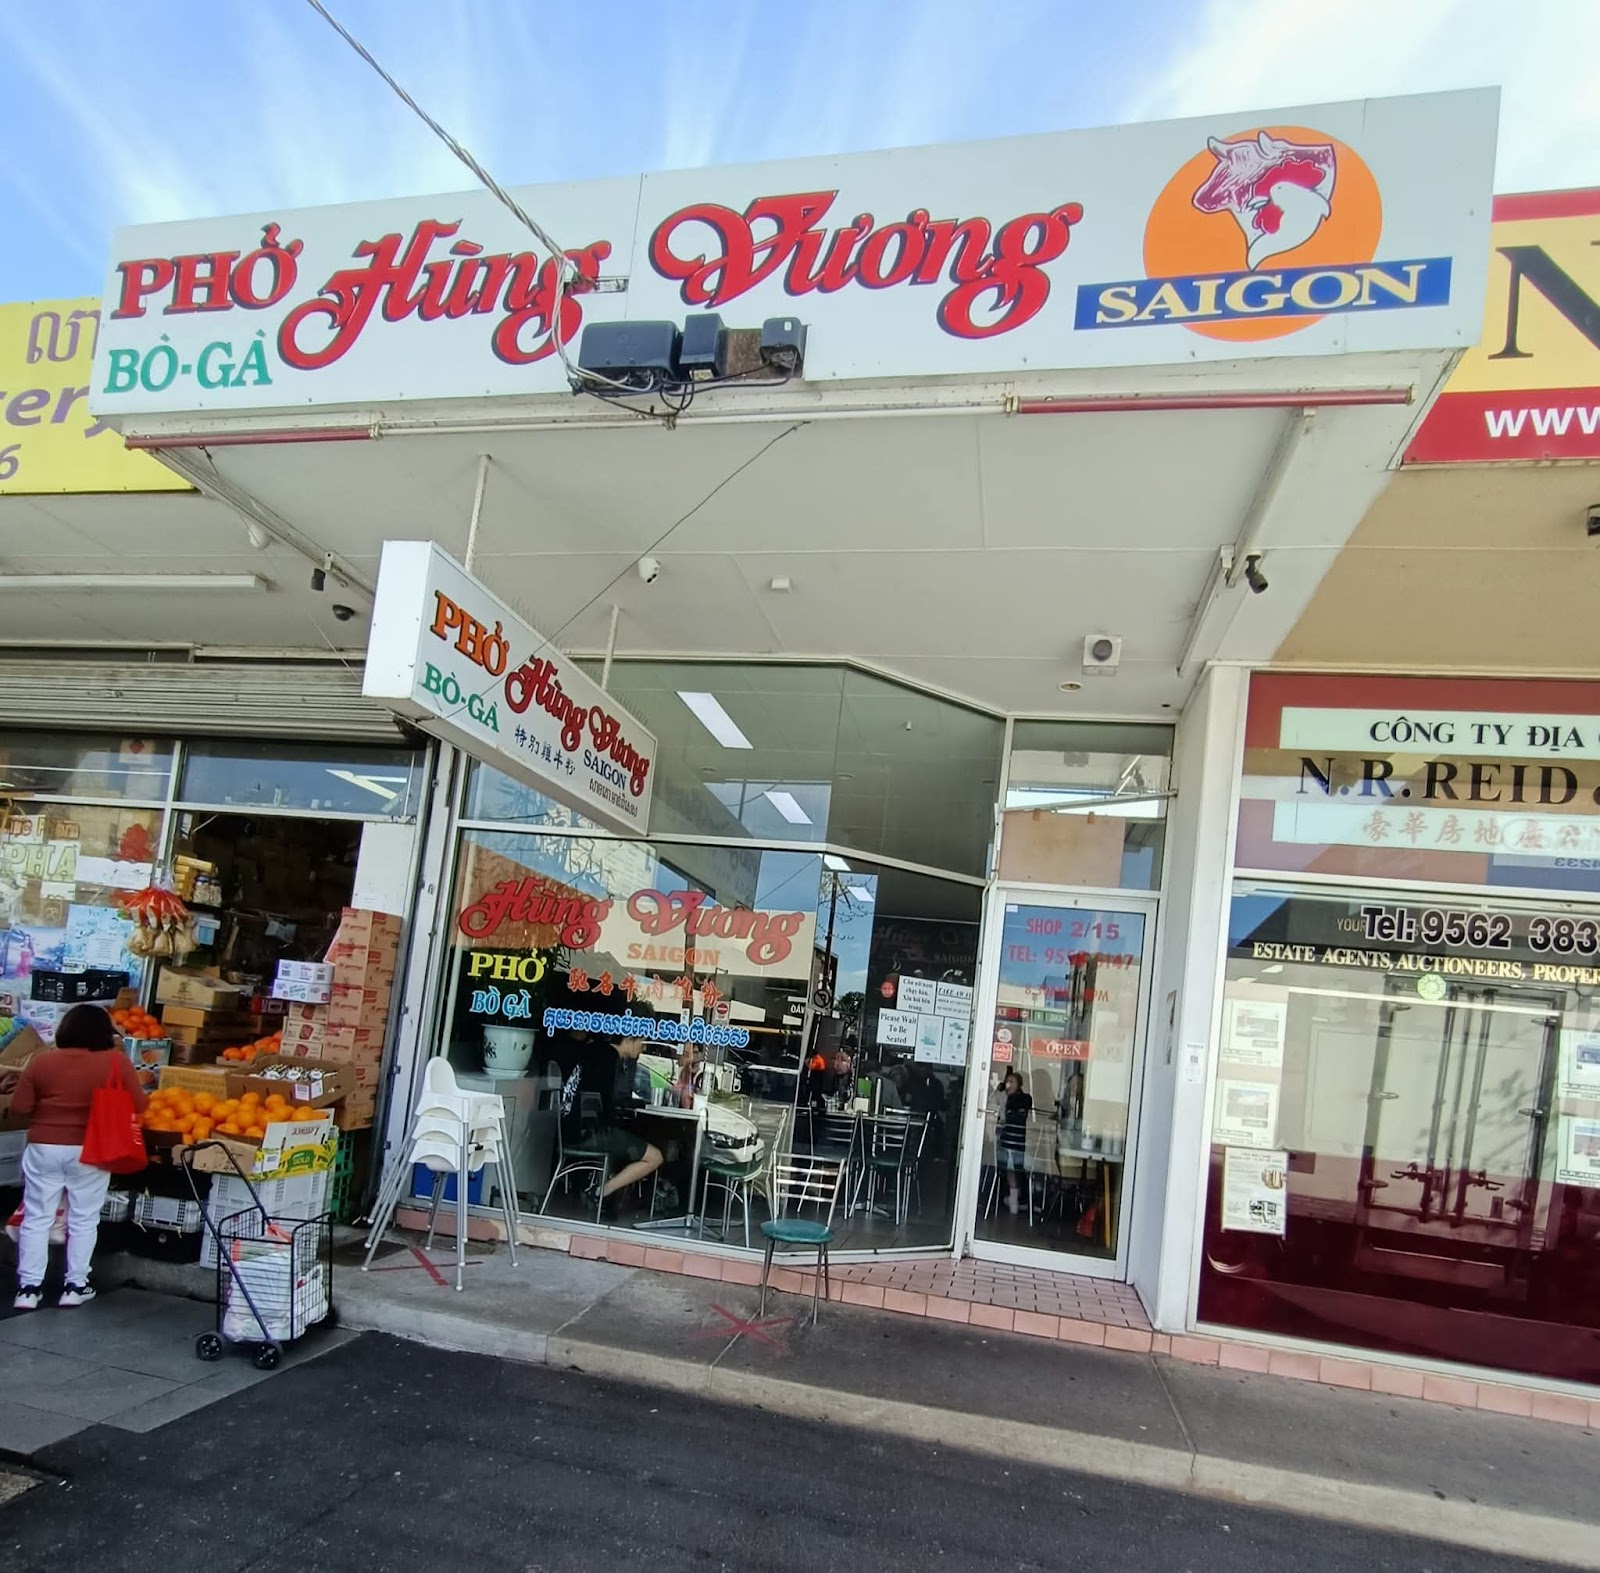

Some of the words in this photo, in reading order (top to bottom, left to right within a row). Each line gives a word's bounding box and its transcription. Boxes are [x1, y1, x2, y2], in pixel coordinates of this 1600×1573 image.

[111, 222, 304, 320] PHỞ
[277, 219, 611, 370] Hùng
[648, 189, 1084, 339] Vương
[1095, 264, 1427, 324] SAIGON
[430, 590, 510, 676] PHỞ
[505, 654, 588, 752] Hùng
[589, 705, 650, 797] Vương
[1370, 716, 1455, 744] CÔNG
[1471, 723, 1513, 746] TY
[1527, 725, 1585, 751] ĐỊA
[583, 749, 627, 790] SAIGON
[459, 877, 614, 950] Hùng
[626, 888, 805, 965] Vương
[1026, 918, 1063, 935] SHOP
[1070, 921, 1120, 940] 2/15
[1361, 905, 1416, 943] Tel:
[1422, 909, 1512, 950] 9562
[1528, 915, 1600, 957] 383
[467, 948, 547, 984] PHỞ
[627, 943, 720, 966] SAIGON
[1008, 944, 1037, 963] TEL:
[1253, 942, 1316, 963] ESTATE
[1321, 950, 1393, 972] AGENTS,
[1396, 953, 1525, 981] AUCTIONEERS,
[470, 986, 500, 1013] BÒ
[503, 991, 531, 1018] GÀ
[880, 1012, 901, 1023] Please
[901, 1015, 917, 1025] Wait
[886, 1034, 907, 1044] Seated
[888, 1024, 897, 1033] To
[898, 1025, 907, 1034] Be
[1046, 1041, 1081, 1056] OPEN
